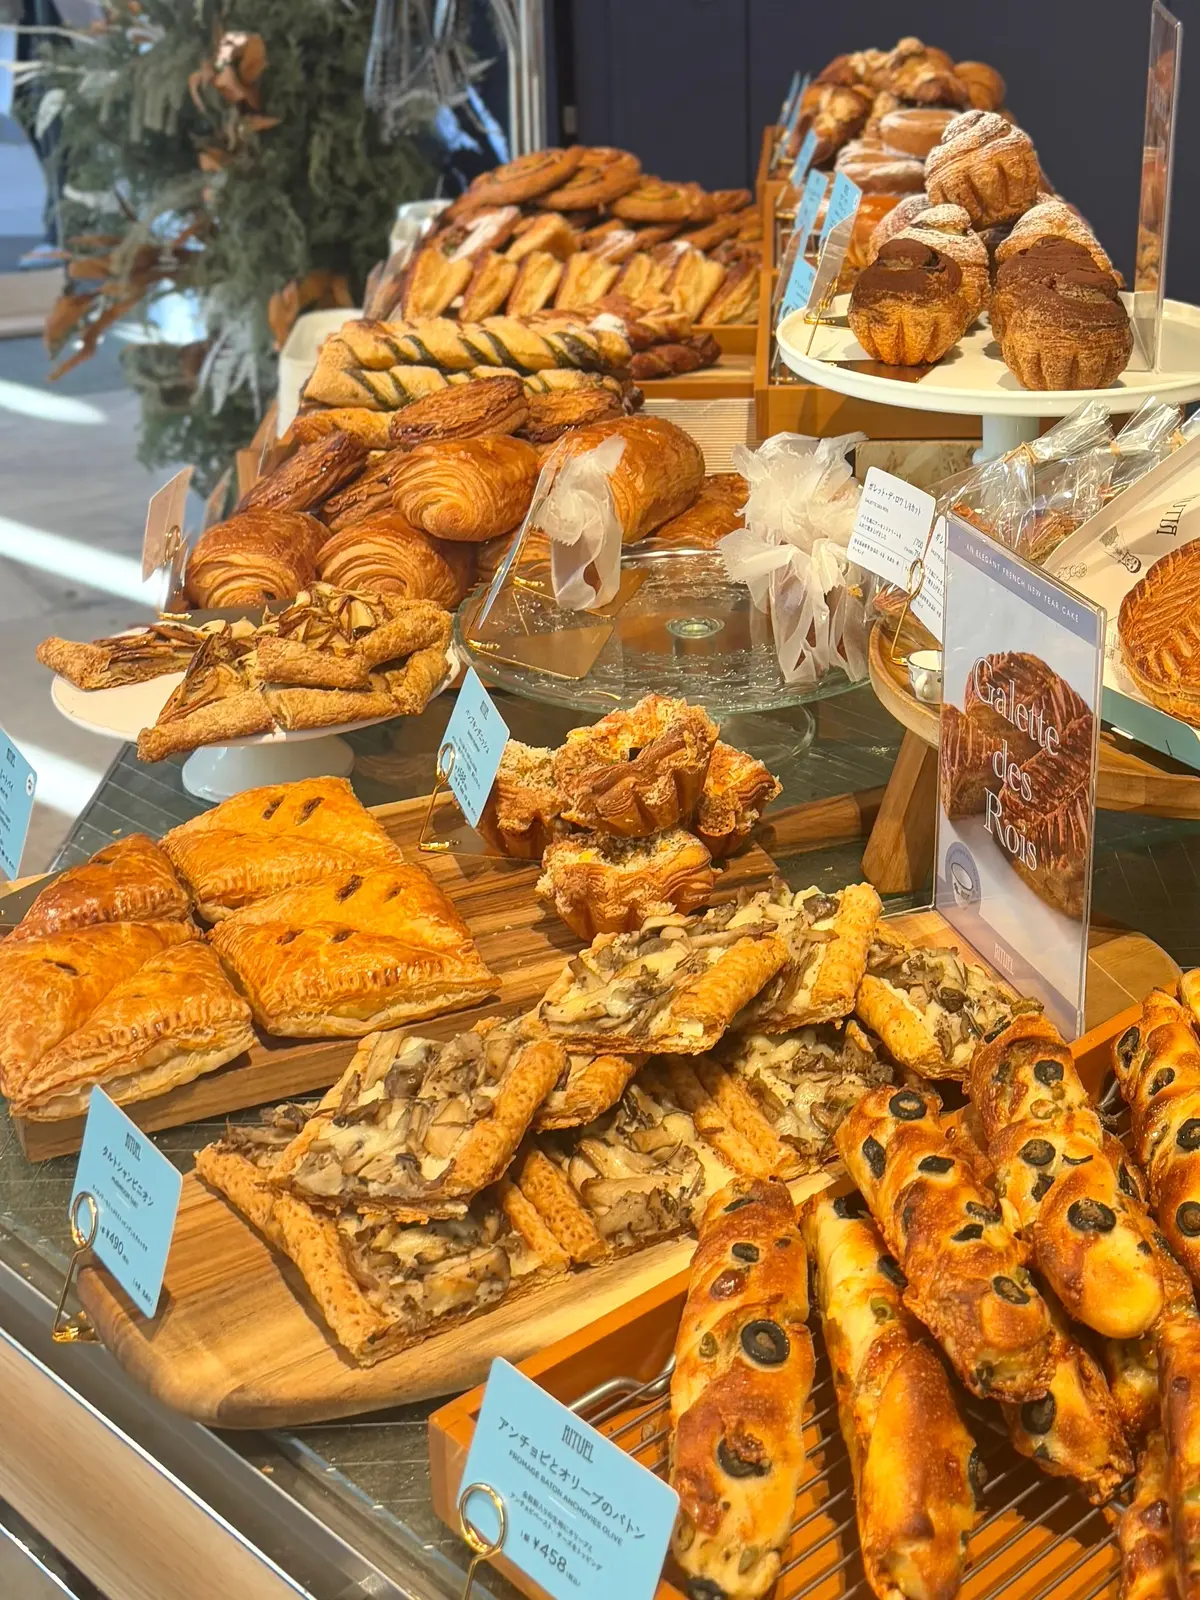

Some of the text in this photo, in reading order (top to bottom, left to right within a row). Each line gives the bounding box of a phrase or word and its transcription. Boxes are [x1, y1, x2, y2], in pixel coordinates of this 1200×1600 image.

[966, 543, 1080, 623] AN ELEGANT FRENCH NEW YEAR CAKE
[972, 656, 1060, 756] Galette
[991, 738, 1032, 802] des
[983, 787, 1038, 872] Rois
[498, 1416, 646, 1541] アンチョビとオリーブのバトン
[561, 1424, 595, 1464] RITUEL
[508, 1449, 624, 1547] FROMAGE BATON ANCHOVIES OLIVE
[532, 1537, 567, 1573] ¥458
